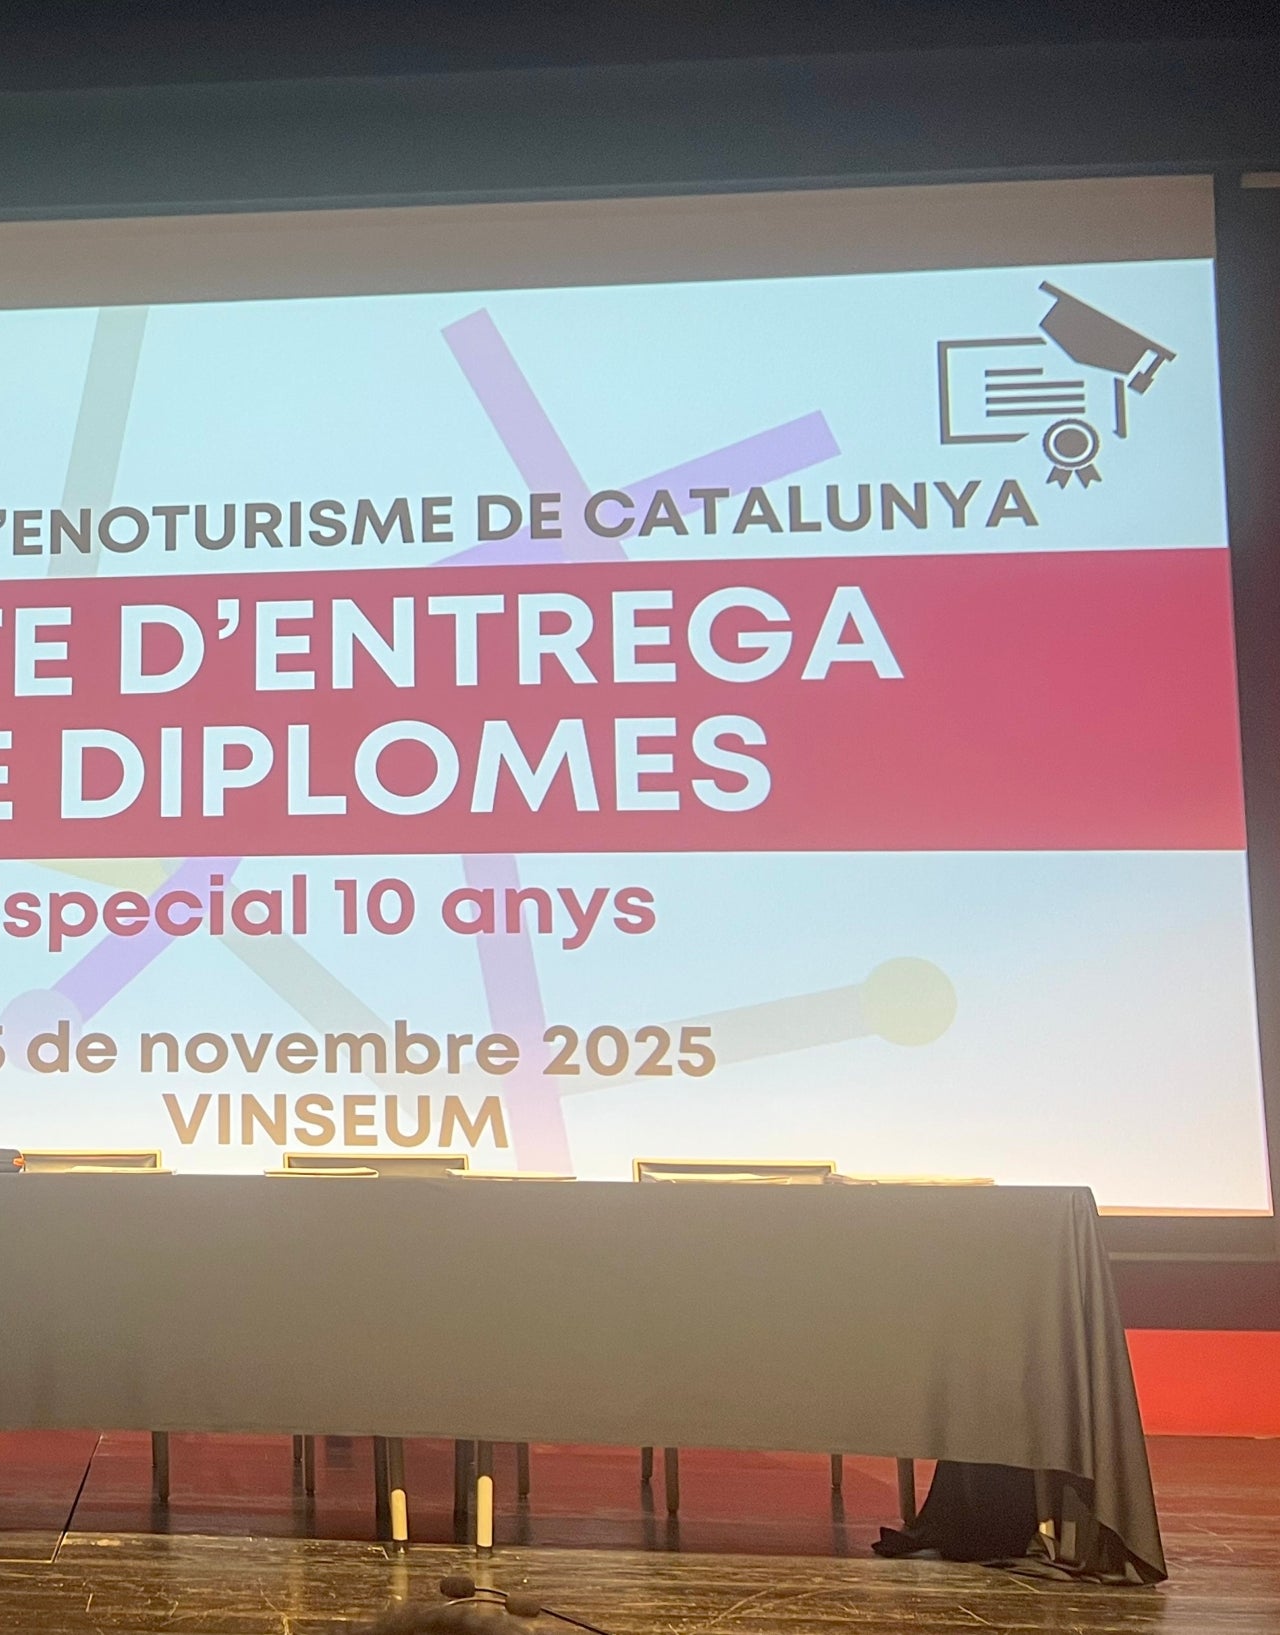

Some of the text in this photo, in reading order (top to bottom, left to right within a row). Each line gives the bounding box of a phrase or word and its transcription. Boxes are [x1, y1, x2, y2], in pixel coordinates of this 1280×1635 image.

[478, 493, 562, 541] DE
[584, 480, 1038, 538] CATALUNYA
[121, 587, 903, 694] D’ENTREGA
[61, 715, 770, 818] DIPLOMES
[335, 879, 414, 935] 10
[442, 887, 655, 950] anys
[27, 1020, 117, 1073] de
[141, 1020, 519, 1075] novembre
[543, 1025, 715, 1077] 2025
[162, 1094, 508, 1148] VINSEUM
